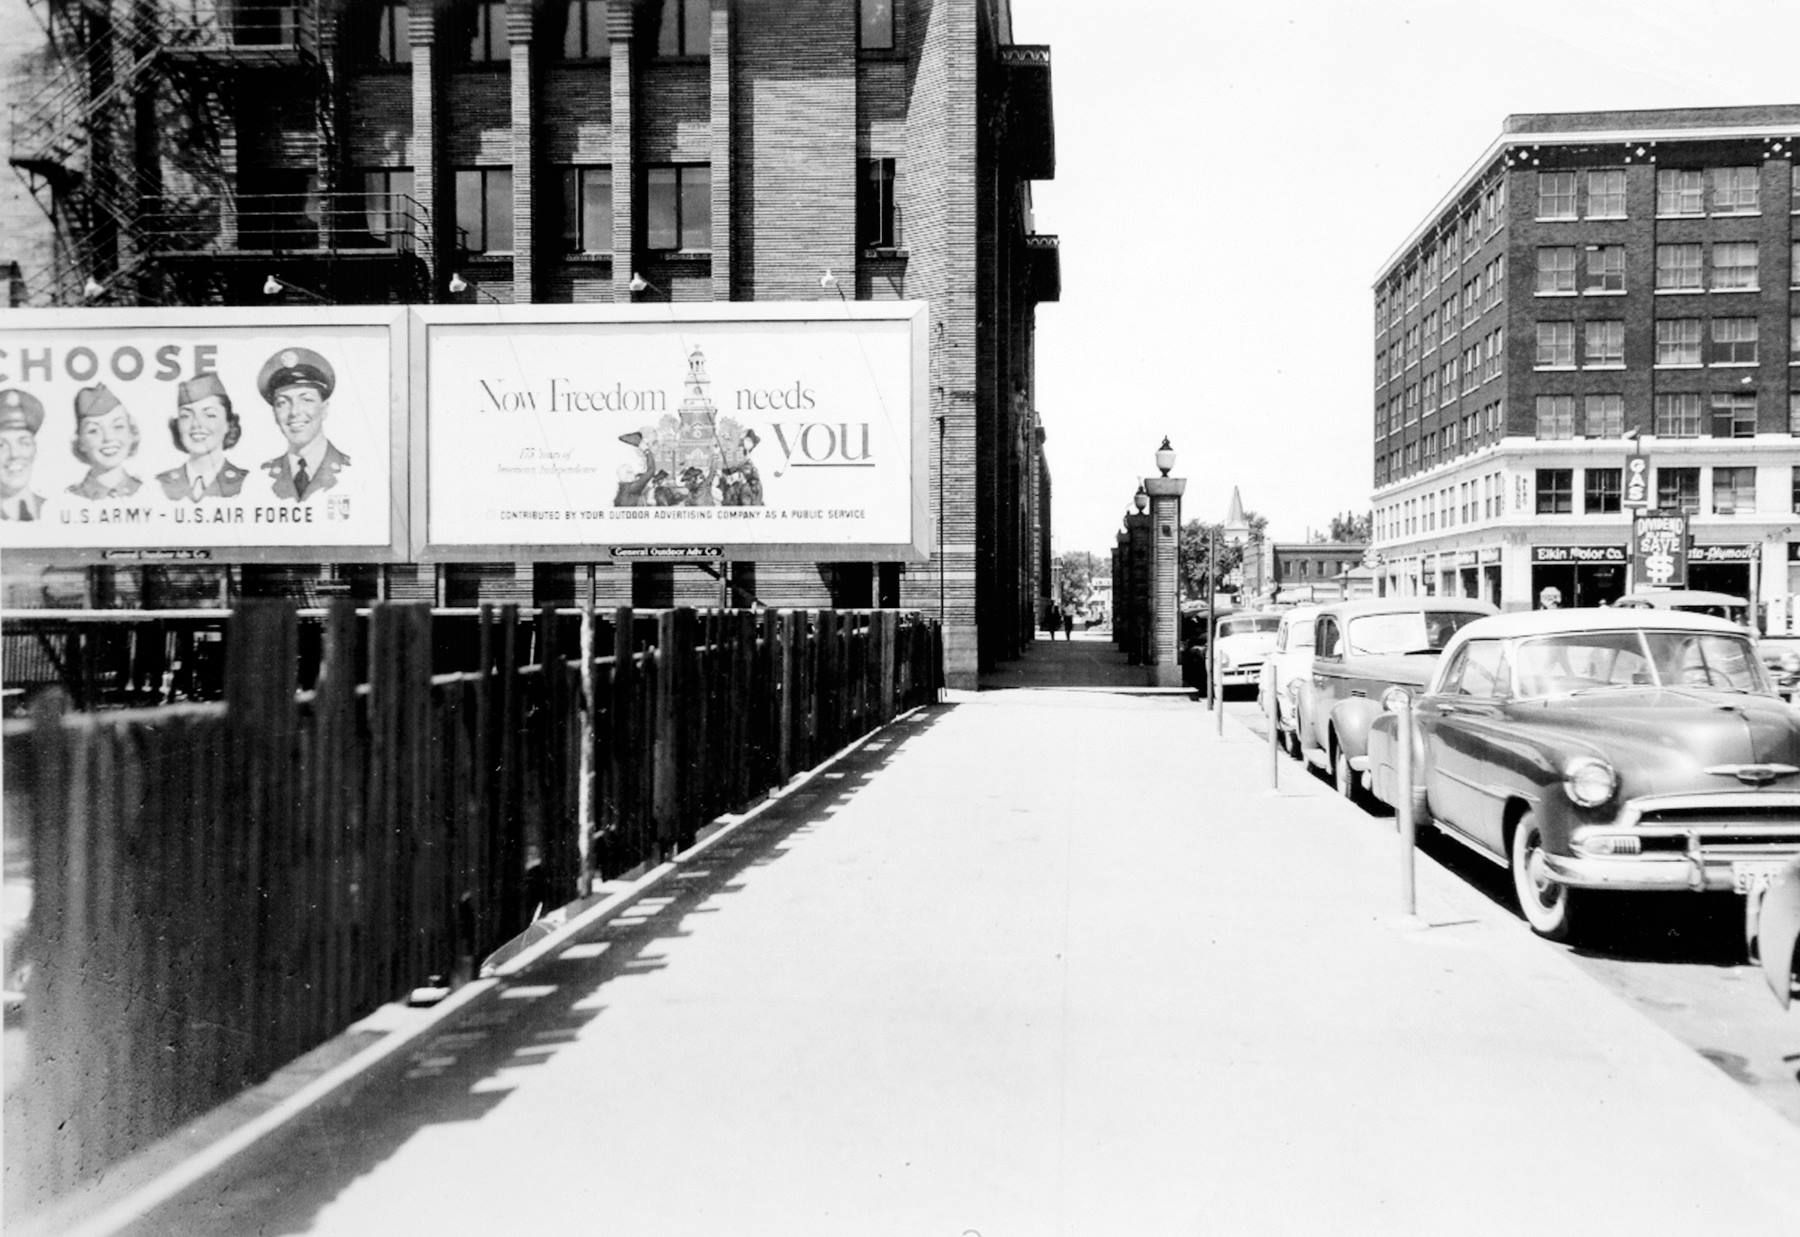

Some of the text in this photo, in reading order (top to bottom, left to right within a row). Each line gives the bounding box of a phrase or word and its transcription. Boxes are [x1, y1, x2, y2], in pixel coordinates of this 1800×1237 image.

[0, 344, 218, 383] HOOSE
[479, 377, 816, 413] Now Freedom needs
[767, 421, 873, 478] you
[1629, 458, 1646, 501] GAS
[255, 507, 314, 523] FORCE
[500, 510, 866, 520] CONTRIBUTED BY YOUR OUTDOOR ADVERTISING COMPANY AS A PUBLIC SERVICE
[615, 547, 648, 556] General
[650, 547, 685, 556] Outdoor
[1537, 547, 1567, 560] Elkin
[1569, 547, 1605, 560] Motor
[1640, 538, 1681, 553] SAVE
